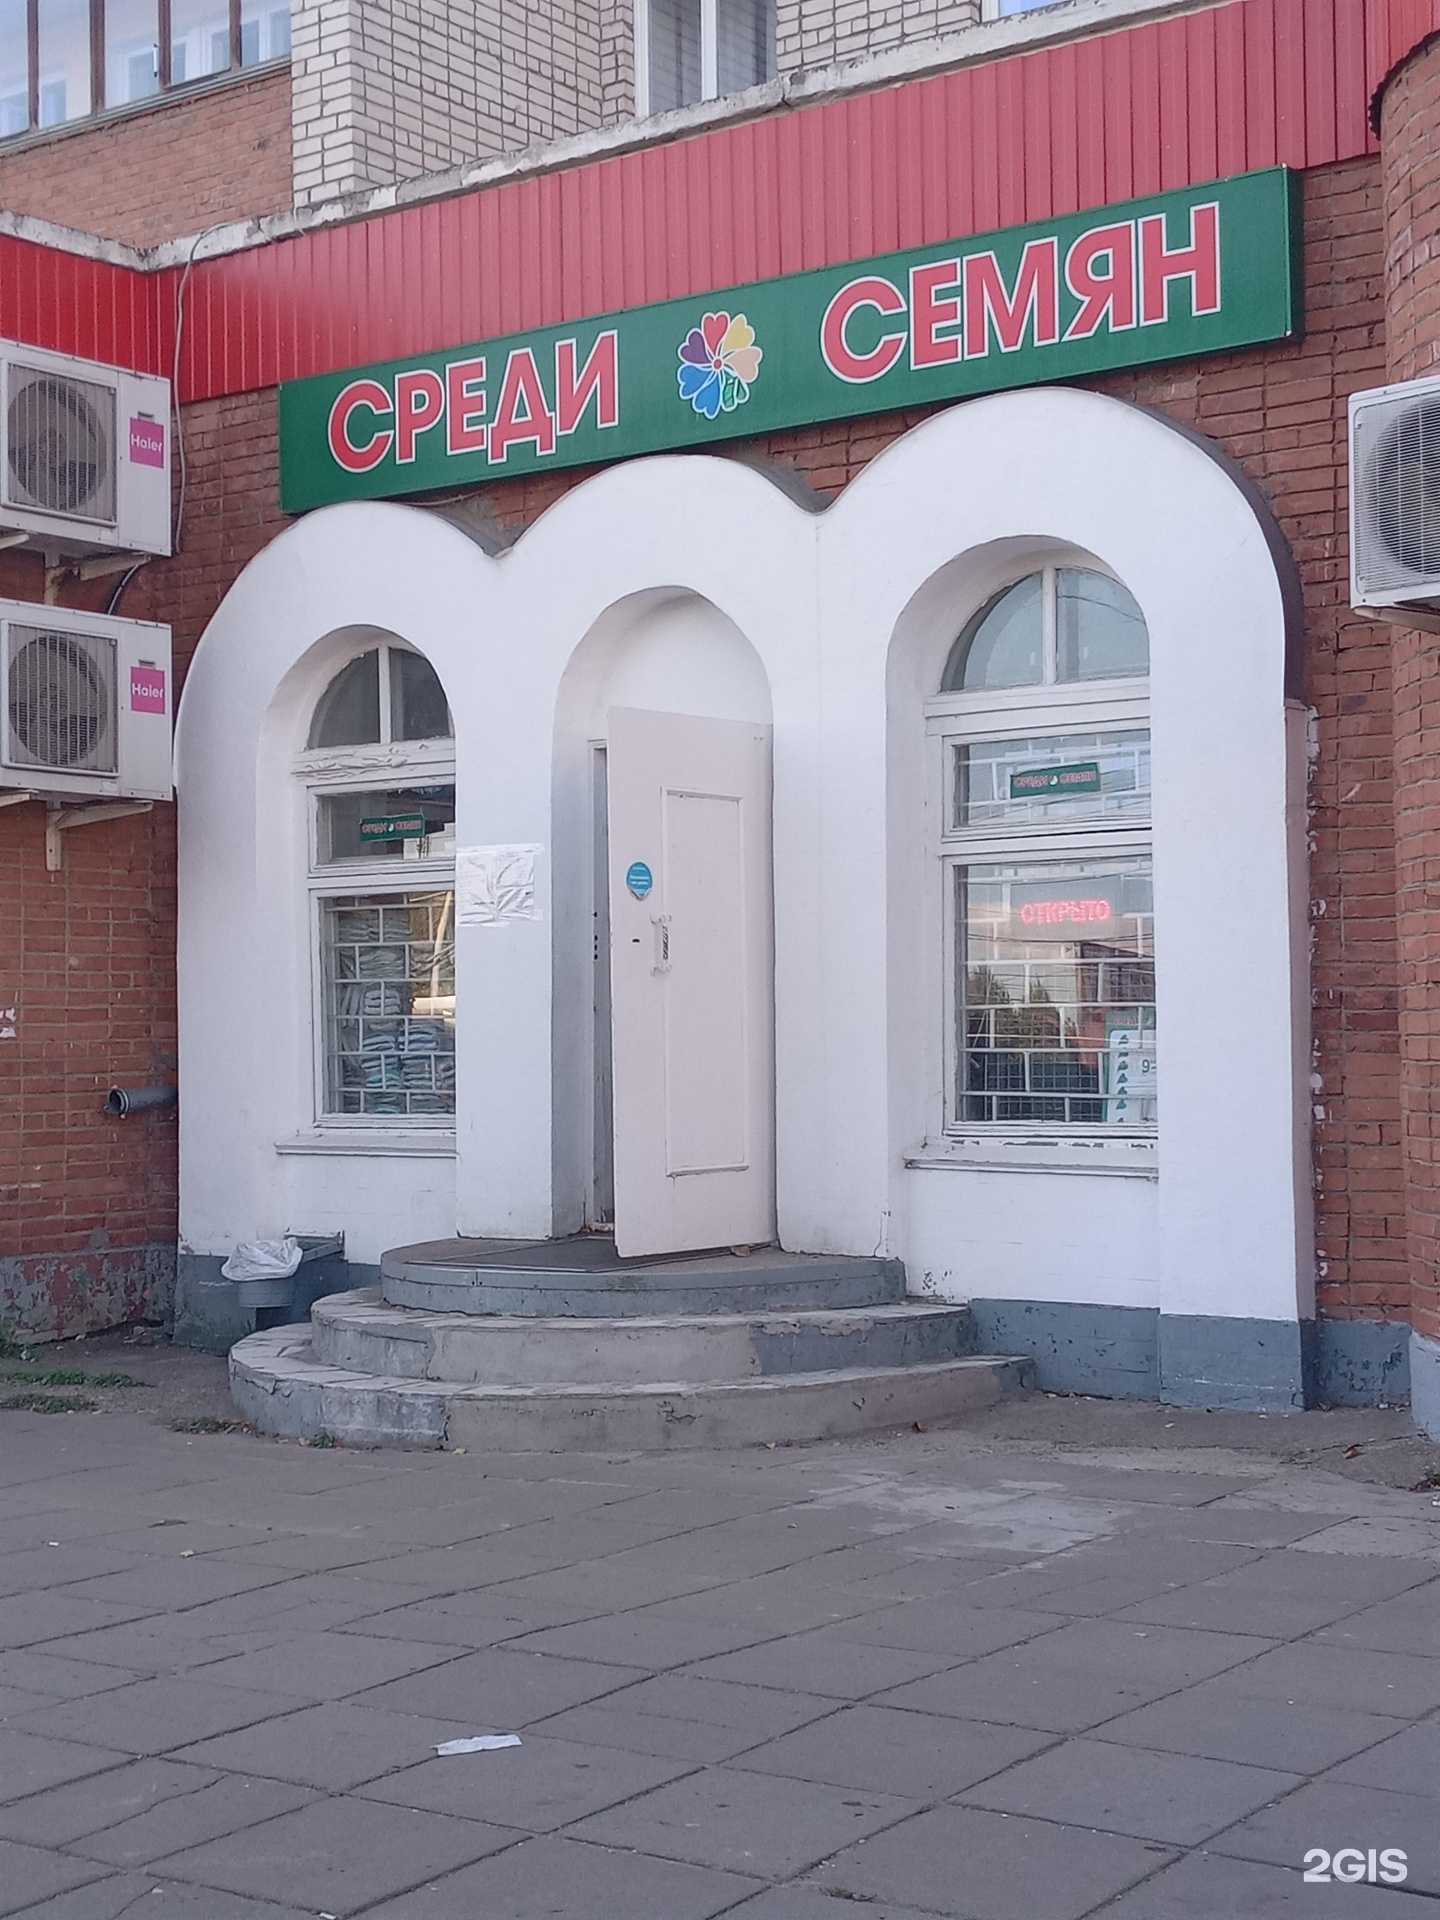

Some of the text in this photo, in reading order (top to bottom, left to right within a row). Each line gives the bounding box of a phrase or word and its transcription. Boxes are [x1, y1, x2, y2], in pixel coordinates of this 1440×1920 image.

[328, 201, 1222, 473] СРЕДИ СЕМЯН
[131, 433, 163, 452] Haier
[132, 682, 164, 699] Haier
[1020, 899, 1110, 924] ОТКРЫТО
